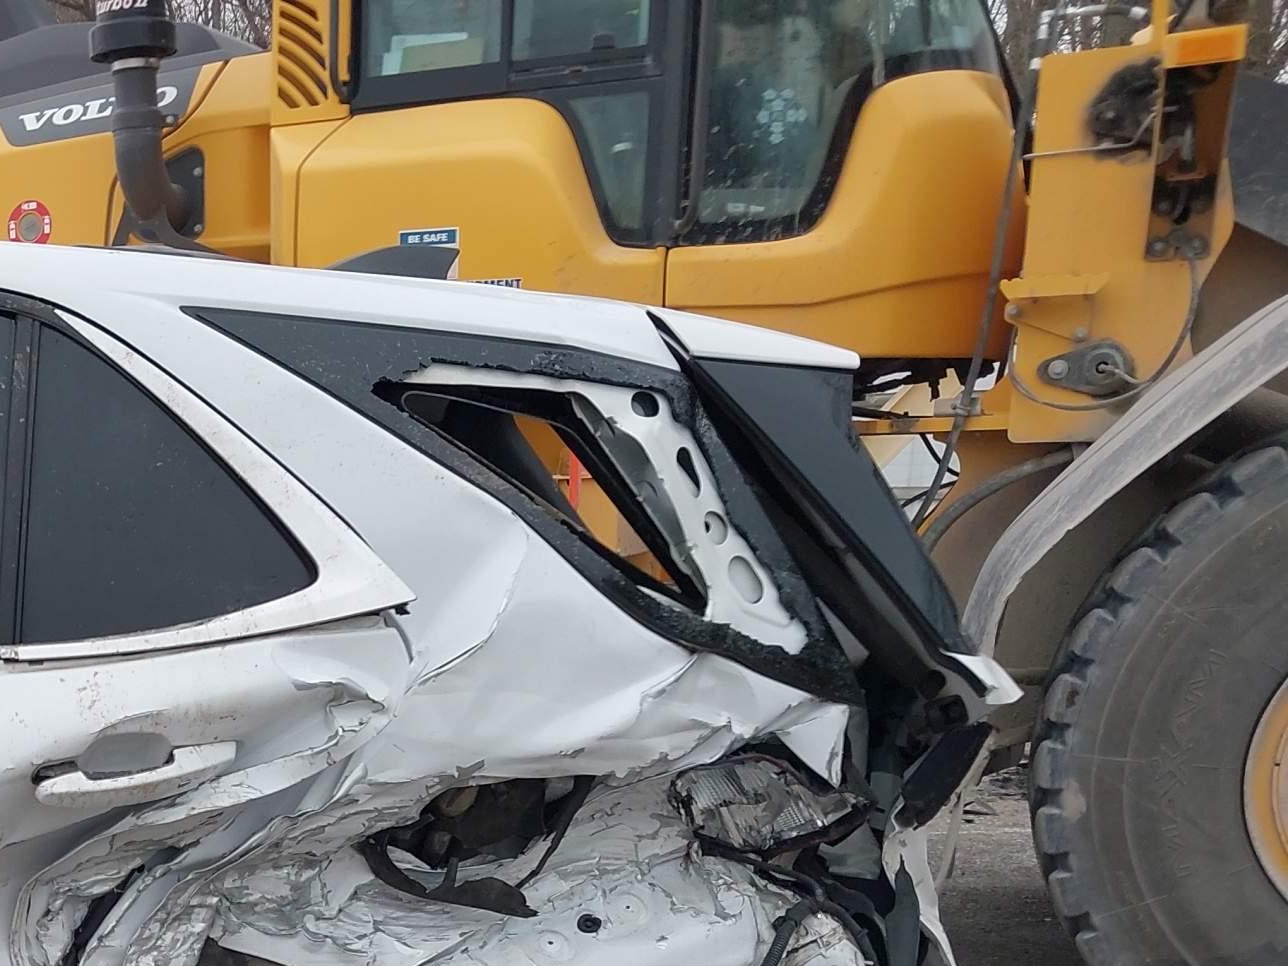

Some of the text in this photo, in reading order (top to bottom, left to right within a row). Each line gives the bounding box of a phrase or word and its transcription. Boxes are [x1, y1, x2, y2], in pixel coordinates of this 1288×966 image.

[18, 86, 178, 132] VOLO
[407, 232, 449, 244] BE SAFE
[1152, 647, 1228, 878] MAXAM
